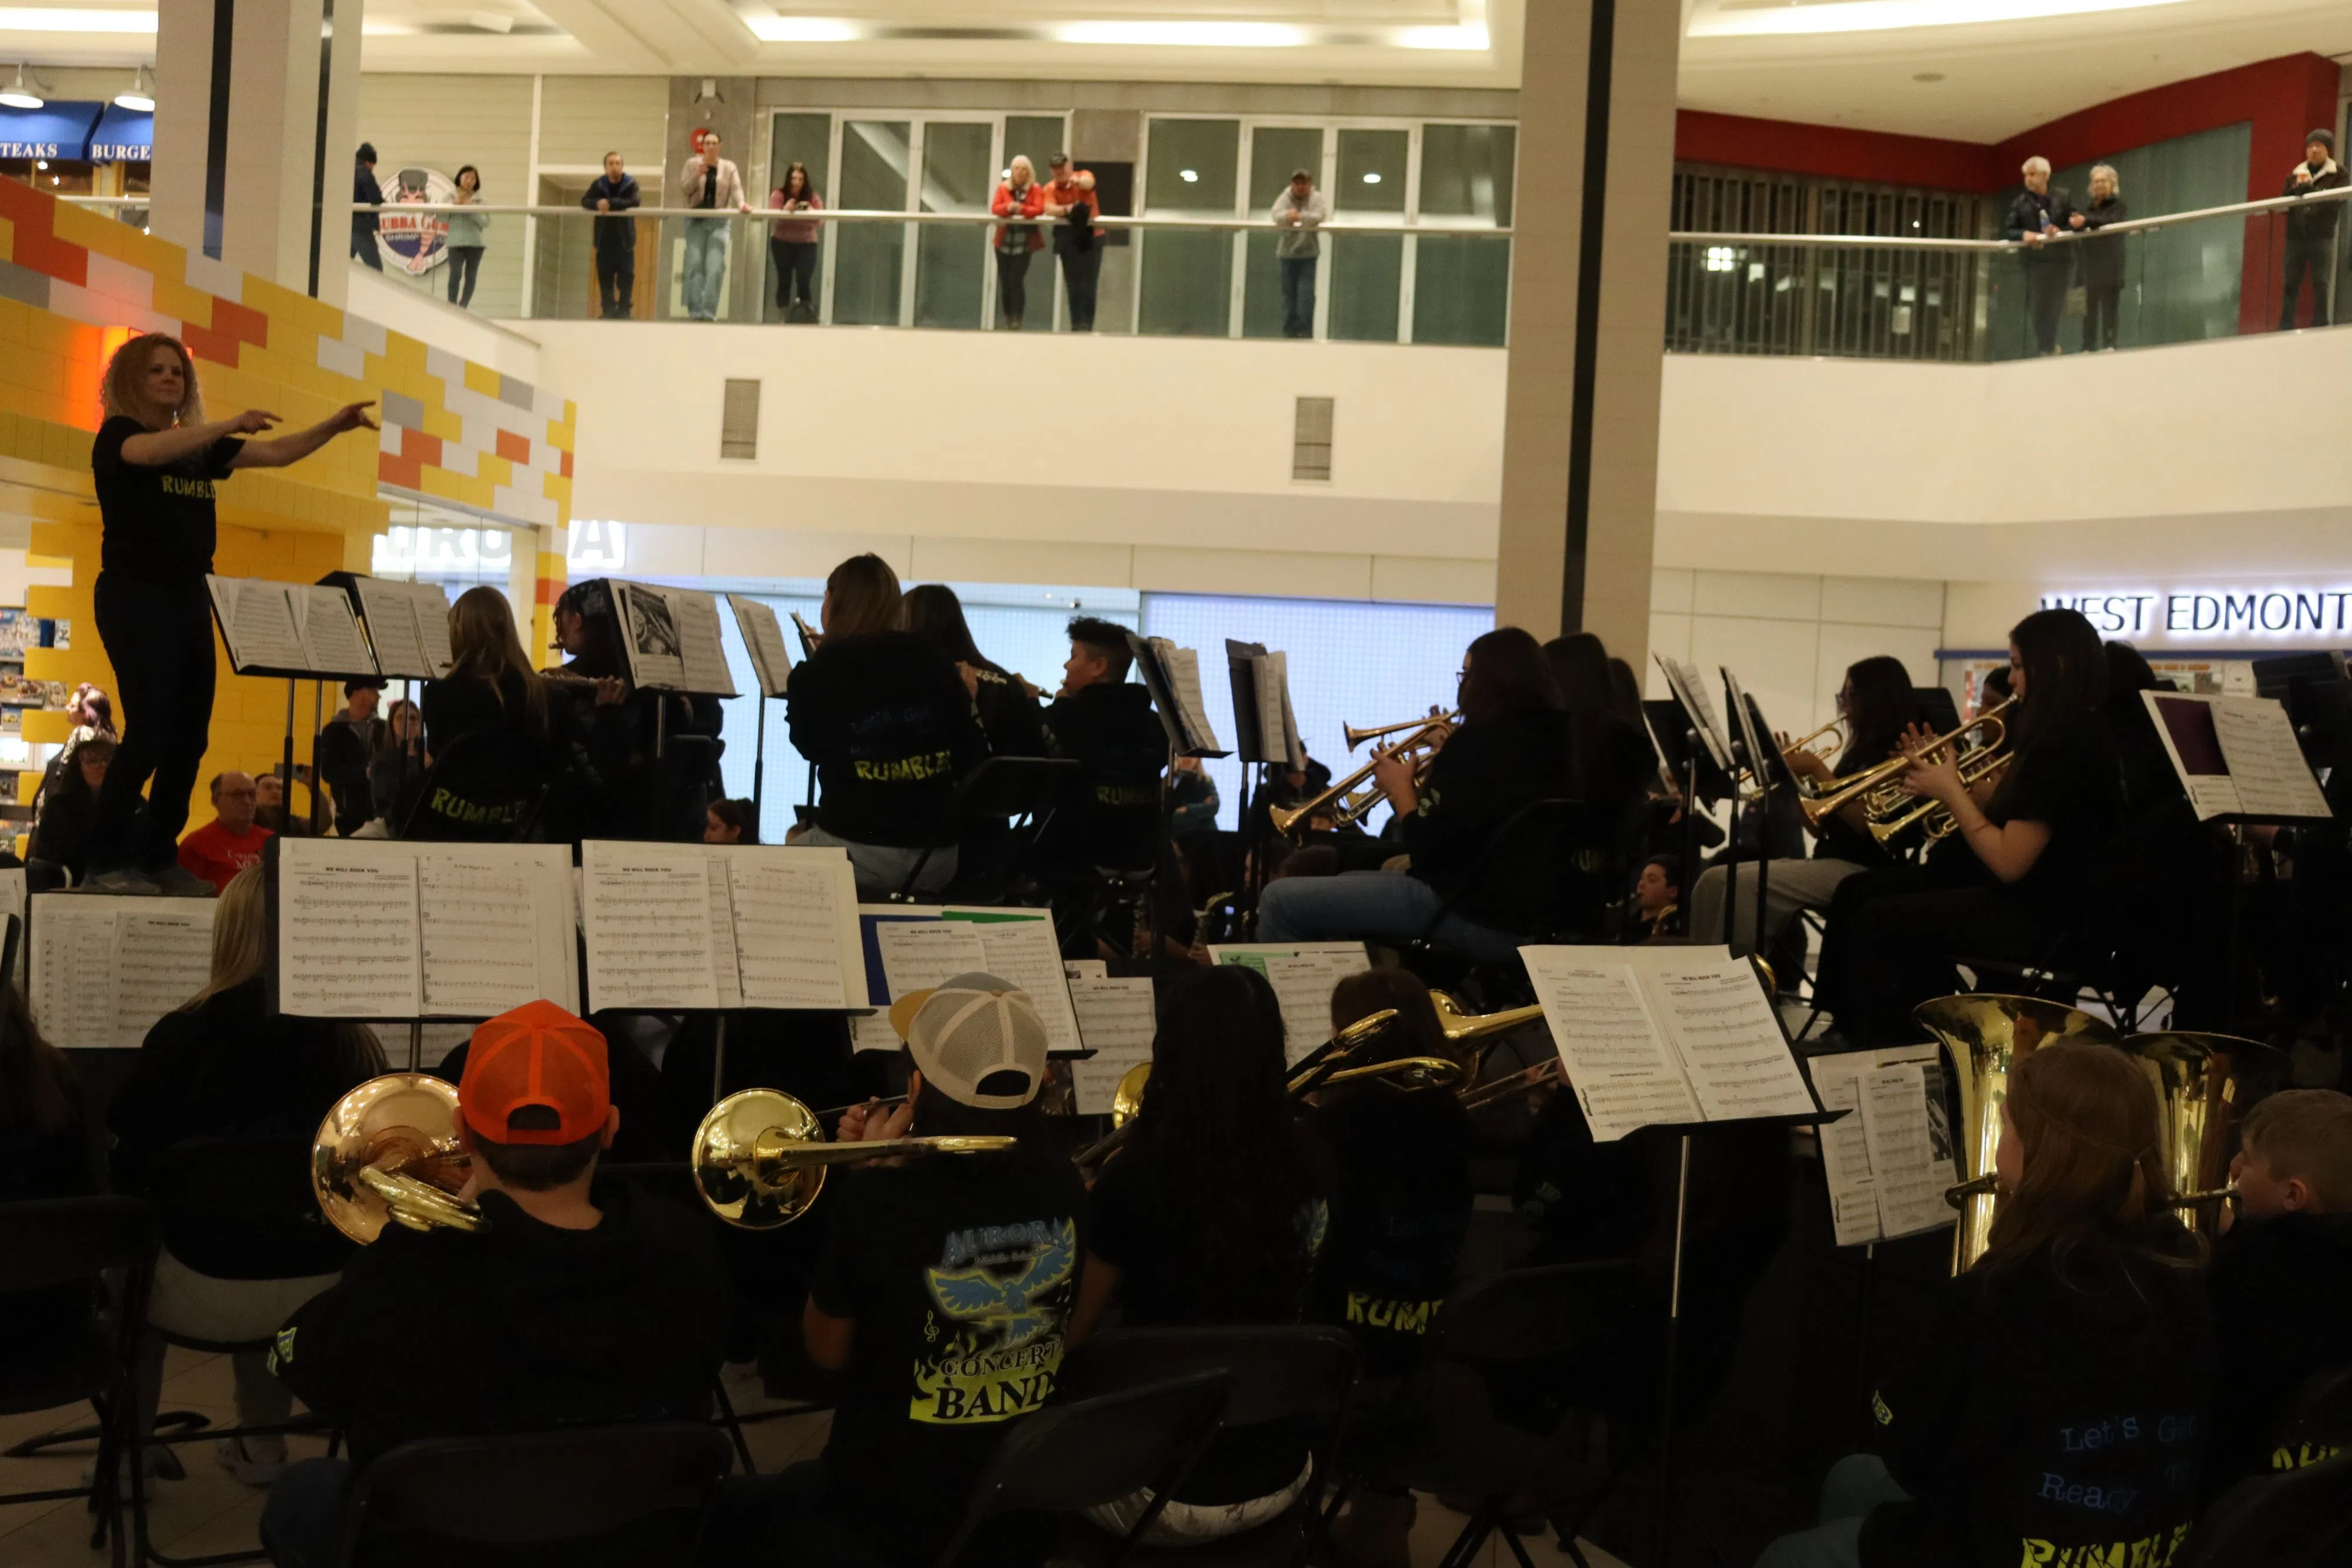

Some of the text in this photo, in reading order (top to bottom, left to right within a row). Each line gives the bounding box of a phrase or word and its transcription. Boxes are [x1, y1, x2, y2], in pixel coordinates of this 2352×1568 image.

[92, 144, 151, 159] BURGE
[381, 216, 416, 230] UBBA
[2166, 593, 2352, 631] EDMONT
[942, 1216, 1065, 1263] AURORA
[1346, 1290, 1444, 1335] RUM
[941, 1340, 1058, 1377] CONCERT
[933, 1370, 1055, 1419] BAND
[2060, 1416, 2140, 1452] Let's
[2036, 1472, 2140, 1514] Ready
